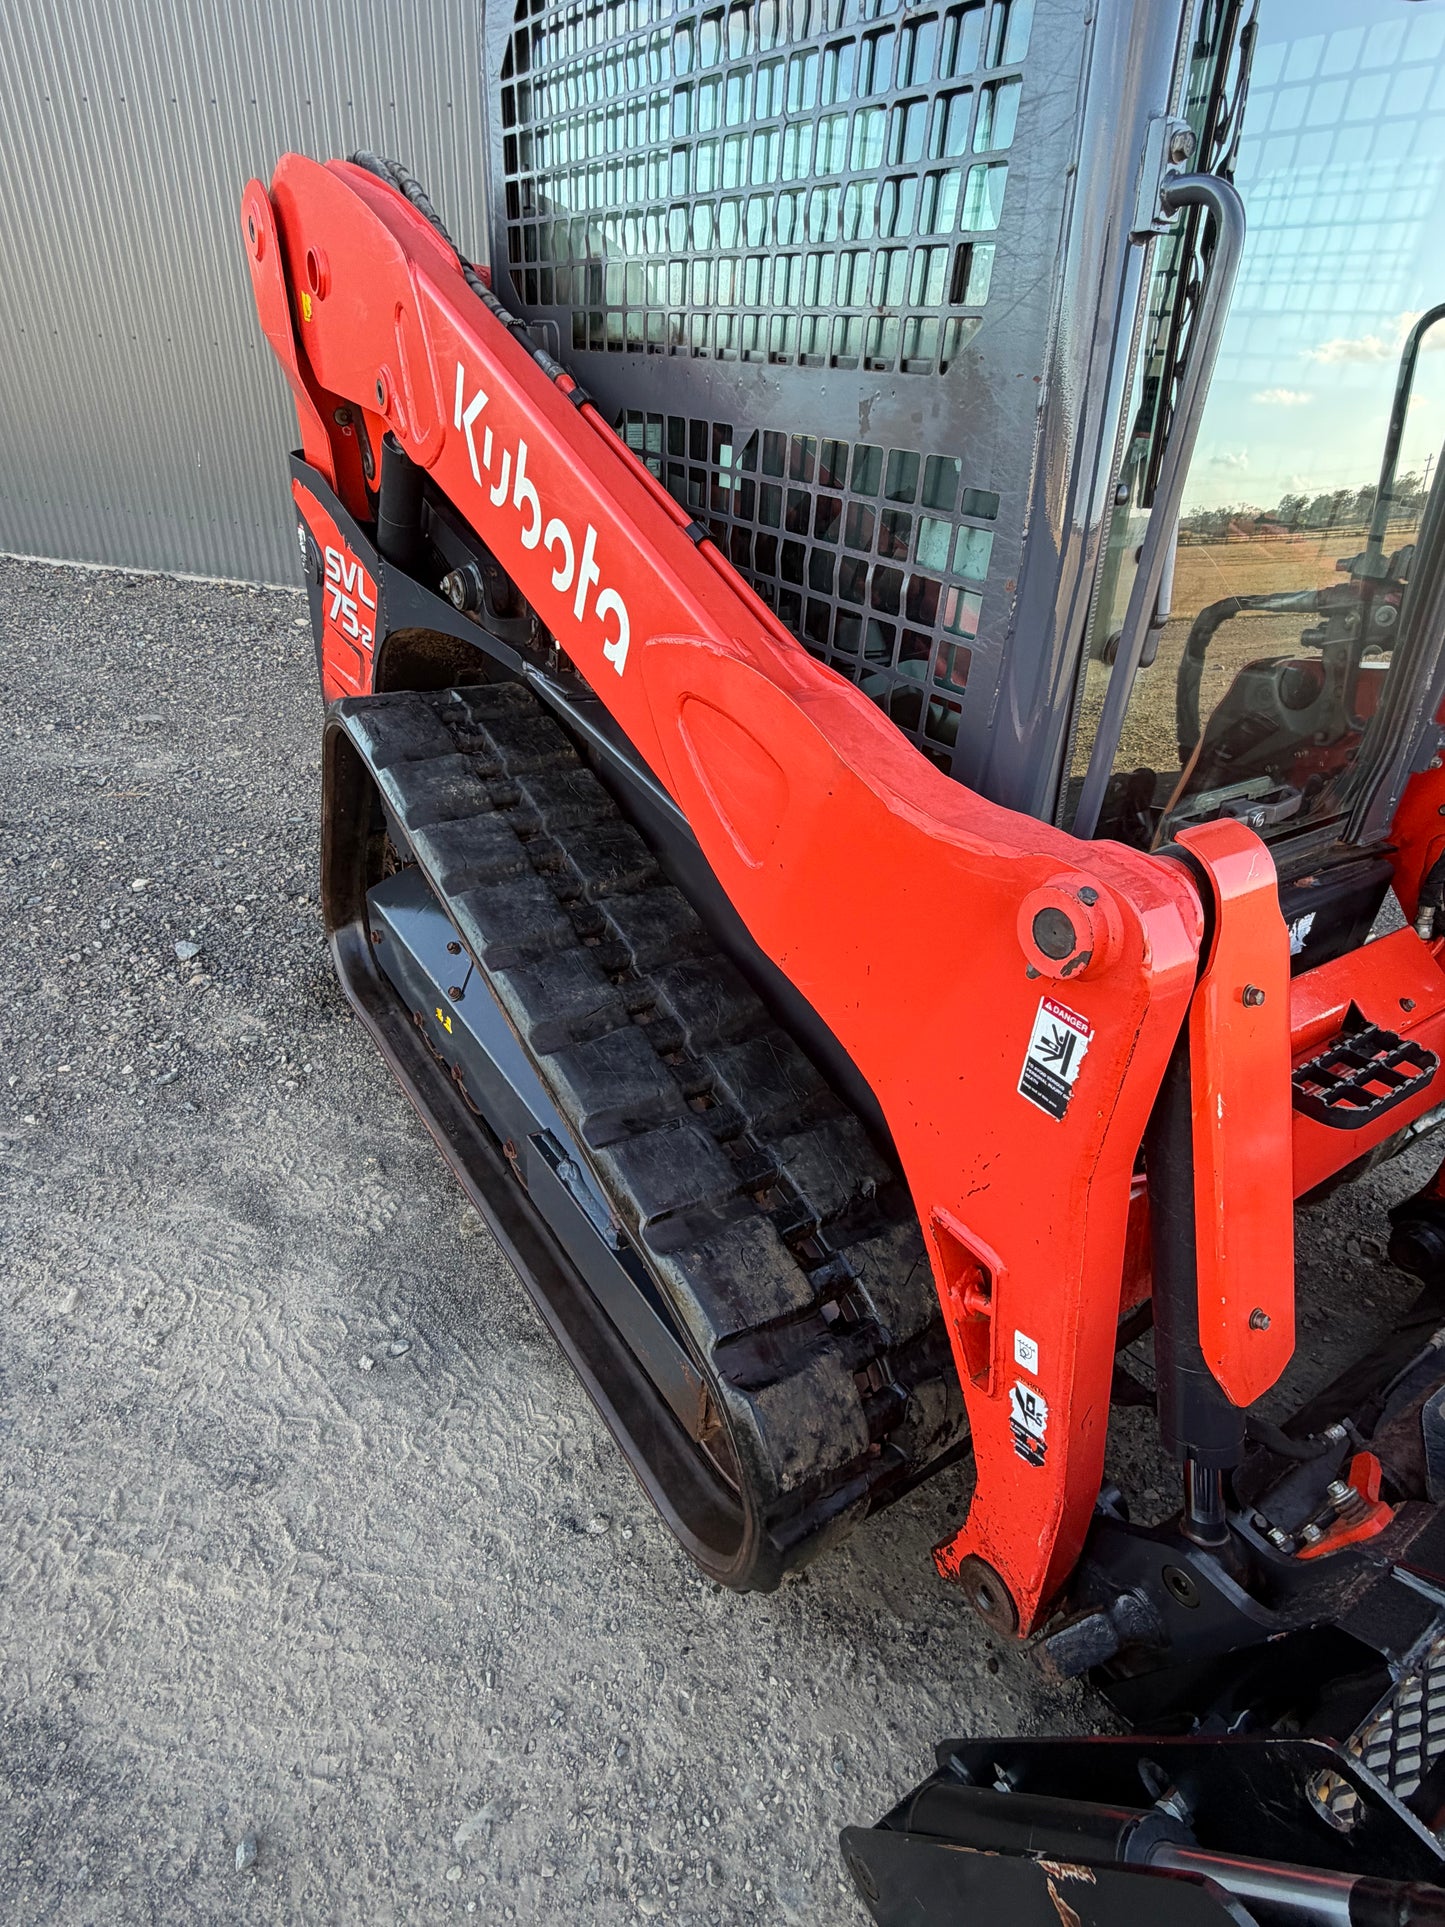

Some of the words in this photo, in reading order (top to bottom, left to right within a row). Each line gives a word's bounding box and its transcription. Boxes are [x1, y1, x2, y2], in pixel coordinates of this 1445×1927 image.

[453, 360, 631, 677] Kubota
[325, 545, 375, 609] SVL
[1052, 1006, 1089, 1034] DANGER
